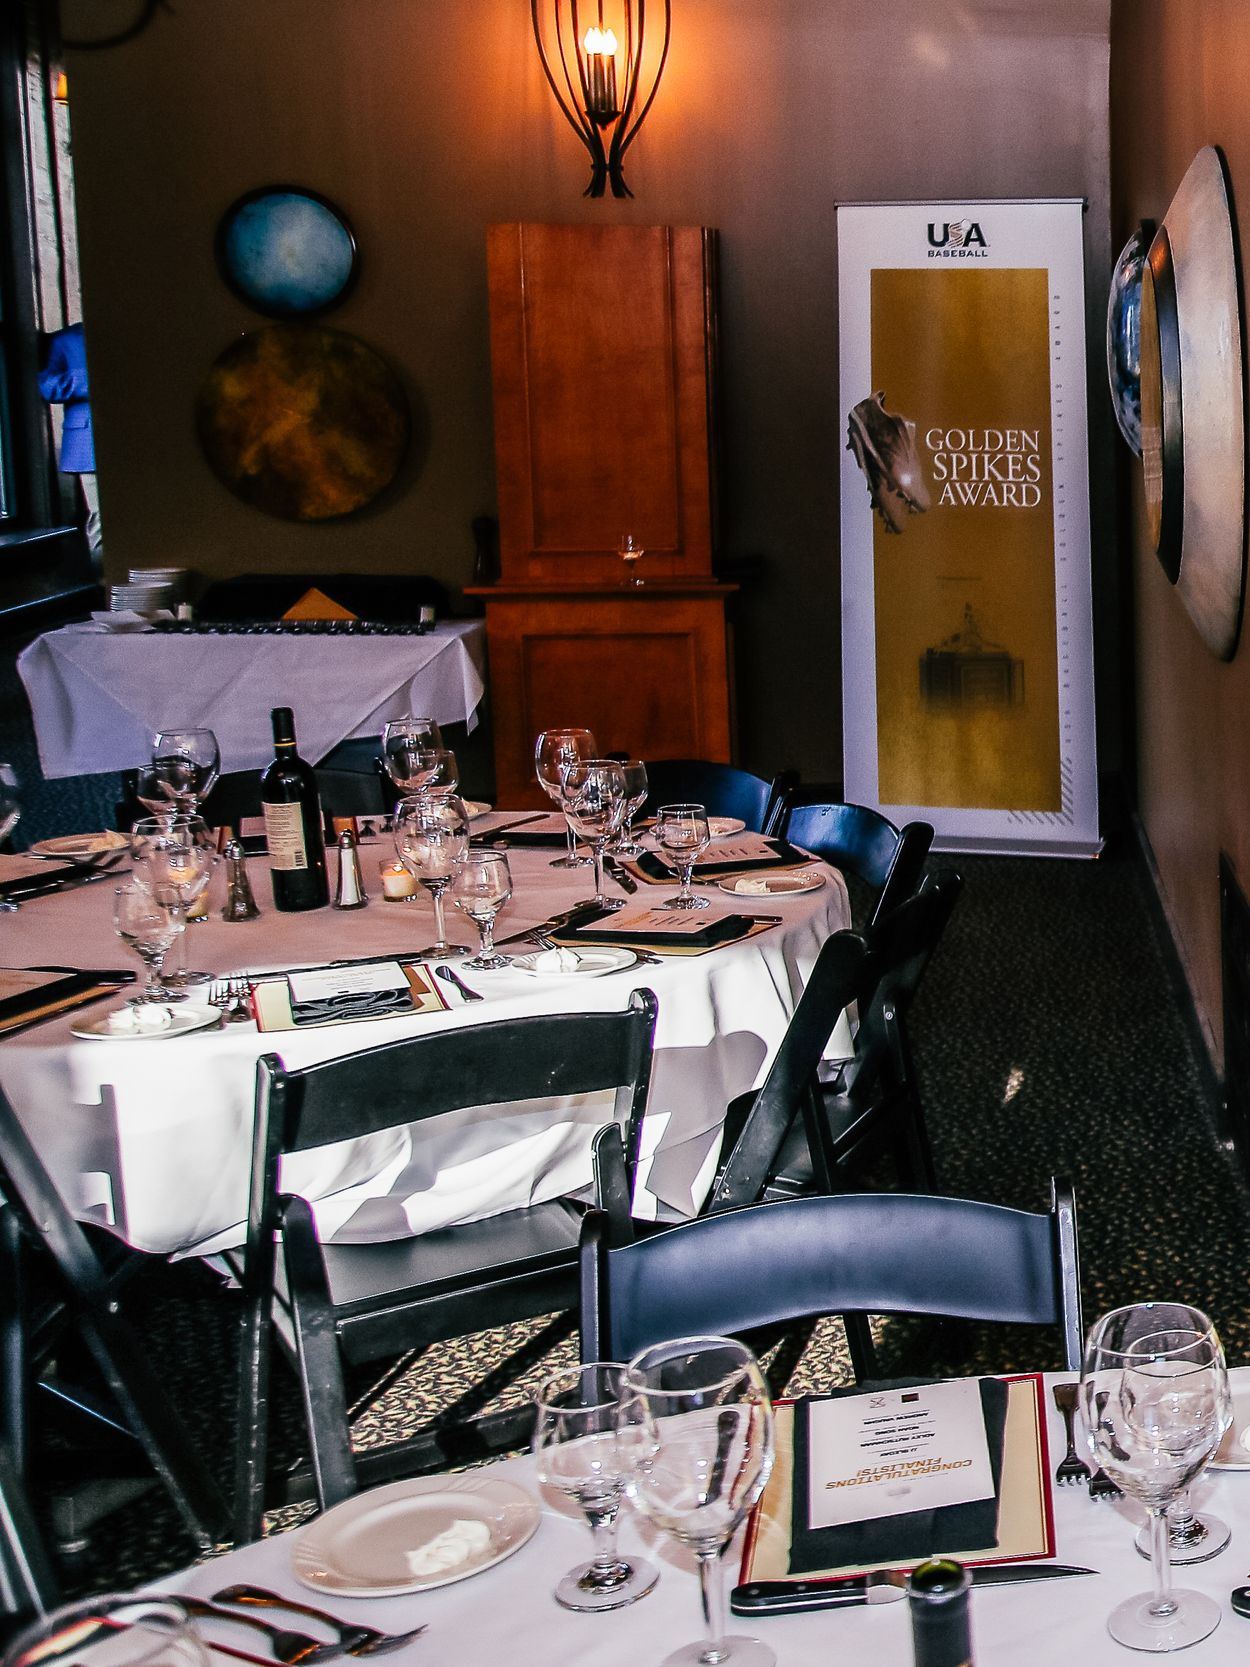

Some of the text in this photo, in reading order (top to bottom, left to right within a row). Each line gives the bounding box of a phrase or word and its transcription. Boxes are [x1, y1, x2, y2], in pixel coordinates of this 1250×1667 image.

[927, 220, 987, 248] USA
[927, 249, 988, 258] BASEBALL
[925, 428, 1040, 452] GOLDEN
[933, 452, 1041, 482] SPIKES
[938, 482, 1042, 508] AWARD
[825, 1459, 973, 1490] CONGRATULATIONS
[856, 1457, 942, 1478] FINALISTS!
